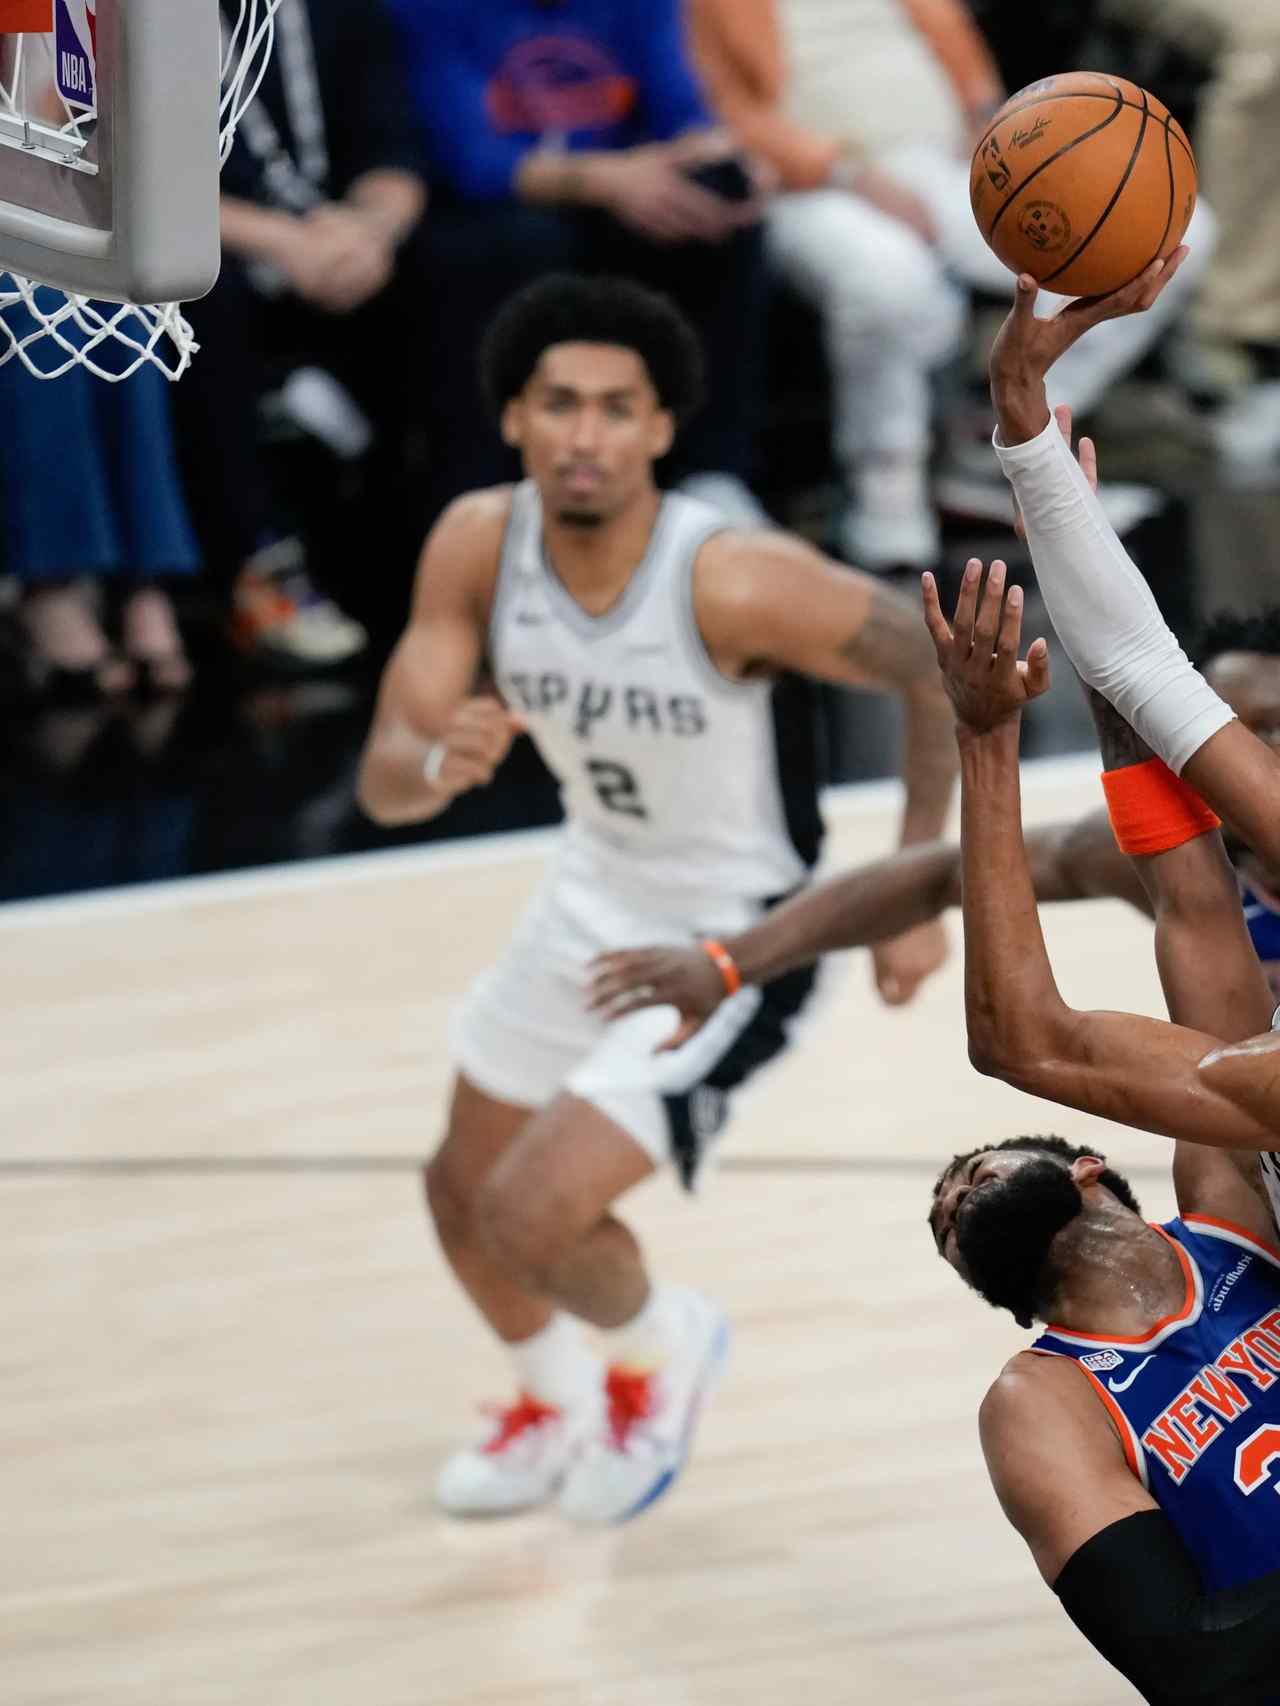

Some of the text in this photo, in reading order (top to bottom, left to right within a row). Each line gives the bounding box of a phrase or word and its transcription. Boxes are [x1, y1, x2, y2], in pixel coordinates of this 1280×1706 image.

[61, 50, 87, 93] NBA
[586, 756, 649, 819] 2
[1213, 1286, 1230, 1312] abu
[1225, 1255, 1253, 1286] dhabi
[1141, 1363, 1252, 1486] NEW
